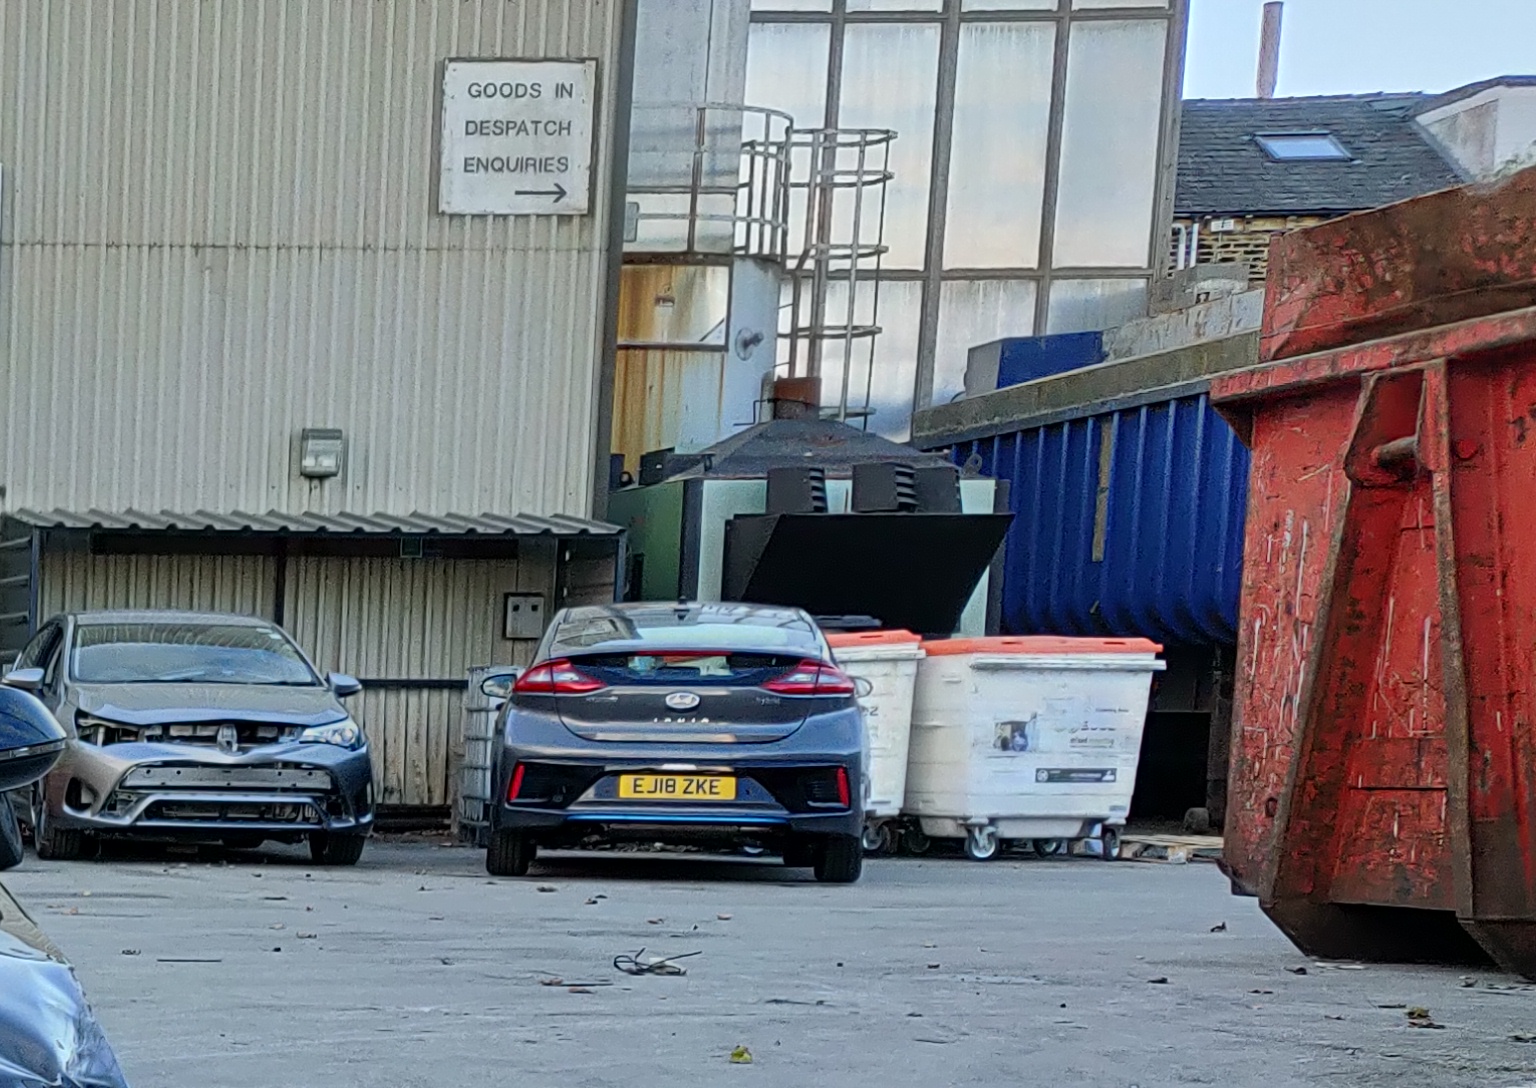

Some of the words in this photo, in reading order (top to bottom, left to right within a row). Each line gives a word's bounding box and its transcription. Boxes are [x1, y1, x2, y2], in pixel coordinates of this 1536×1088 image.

[467, 82, 542, 98] GOODS
[555, 82, 574, 98] IN
[465, 119, 572, 136] DESPATCH
[463, 156, 569, 173] ENQUIRIES
[632, 777, 676, 795] EJ18
[683, 778, 721, 796] ZKE
